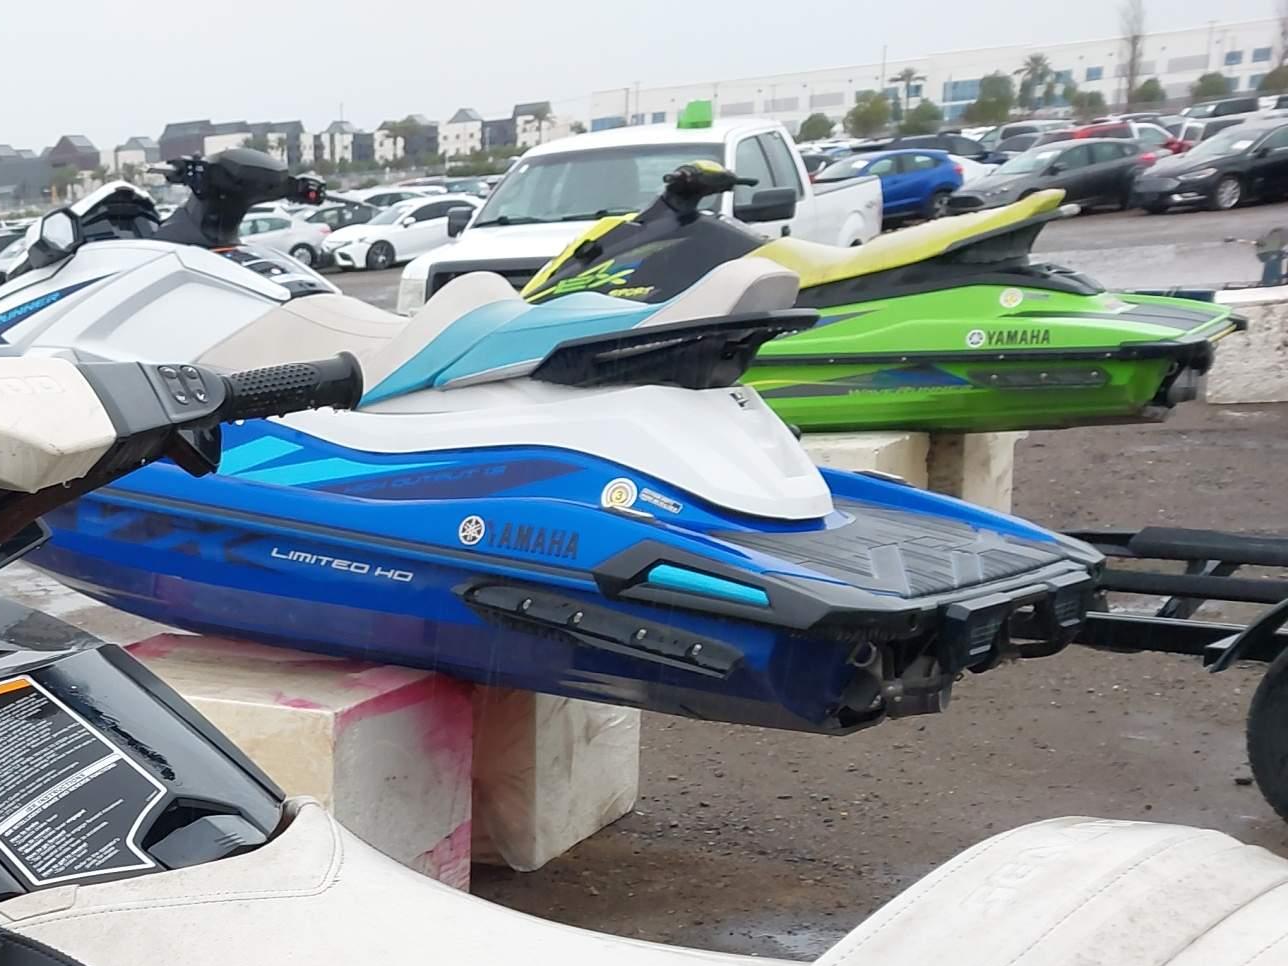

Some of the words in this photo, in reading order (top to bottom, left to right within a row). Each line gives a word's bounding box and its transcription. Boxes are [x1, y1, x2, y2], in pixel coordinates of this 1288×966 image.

[987, 329, 1050, 345] YAMAHA
[486, 519, 580, 561] YAMAHA
[270, 547, 370, 574] LIMITED
[374, 566, 414, 582] HD
